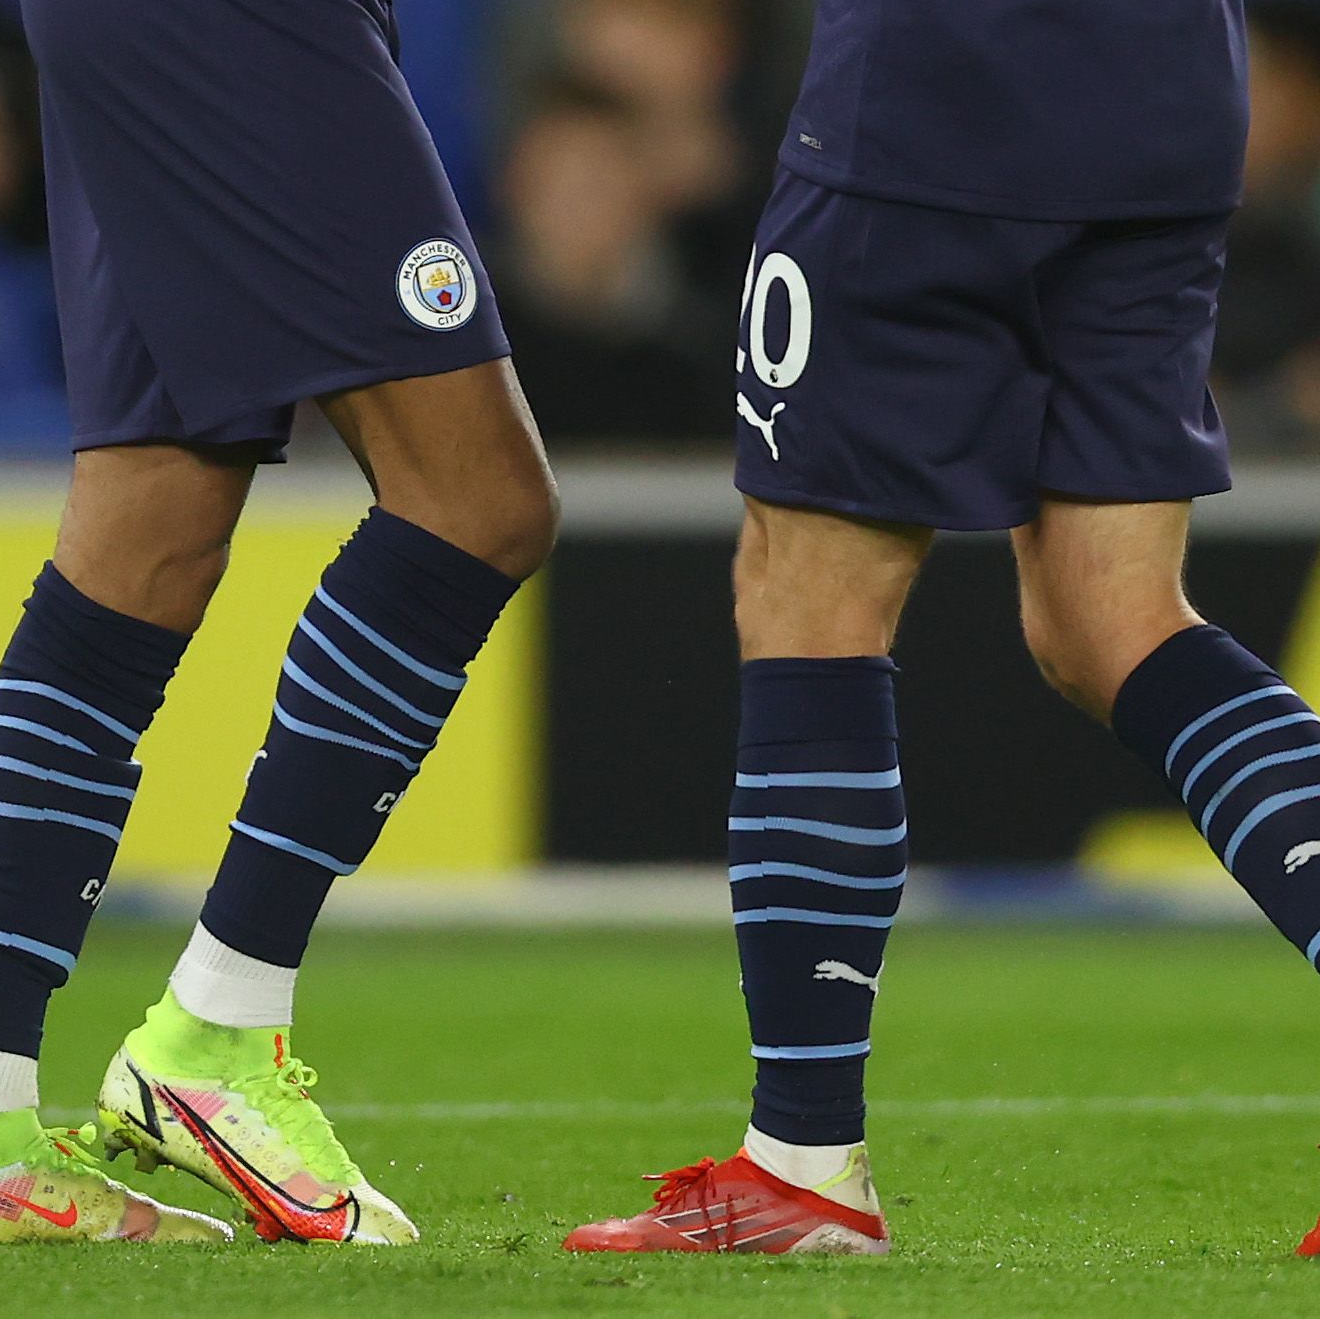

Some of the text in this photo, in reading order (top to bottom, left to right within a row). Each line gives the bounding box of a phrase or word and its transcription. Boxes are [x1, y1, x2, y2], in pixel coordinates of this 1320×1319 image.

[402, 243, 466, 280] MANCHESTER
[437, 312, 462, 326] CITY
[736, 241, 812, 389] 0
